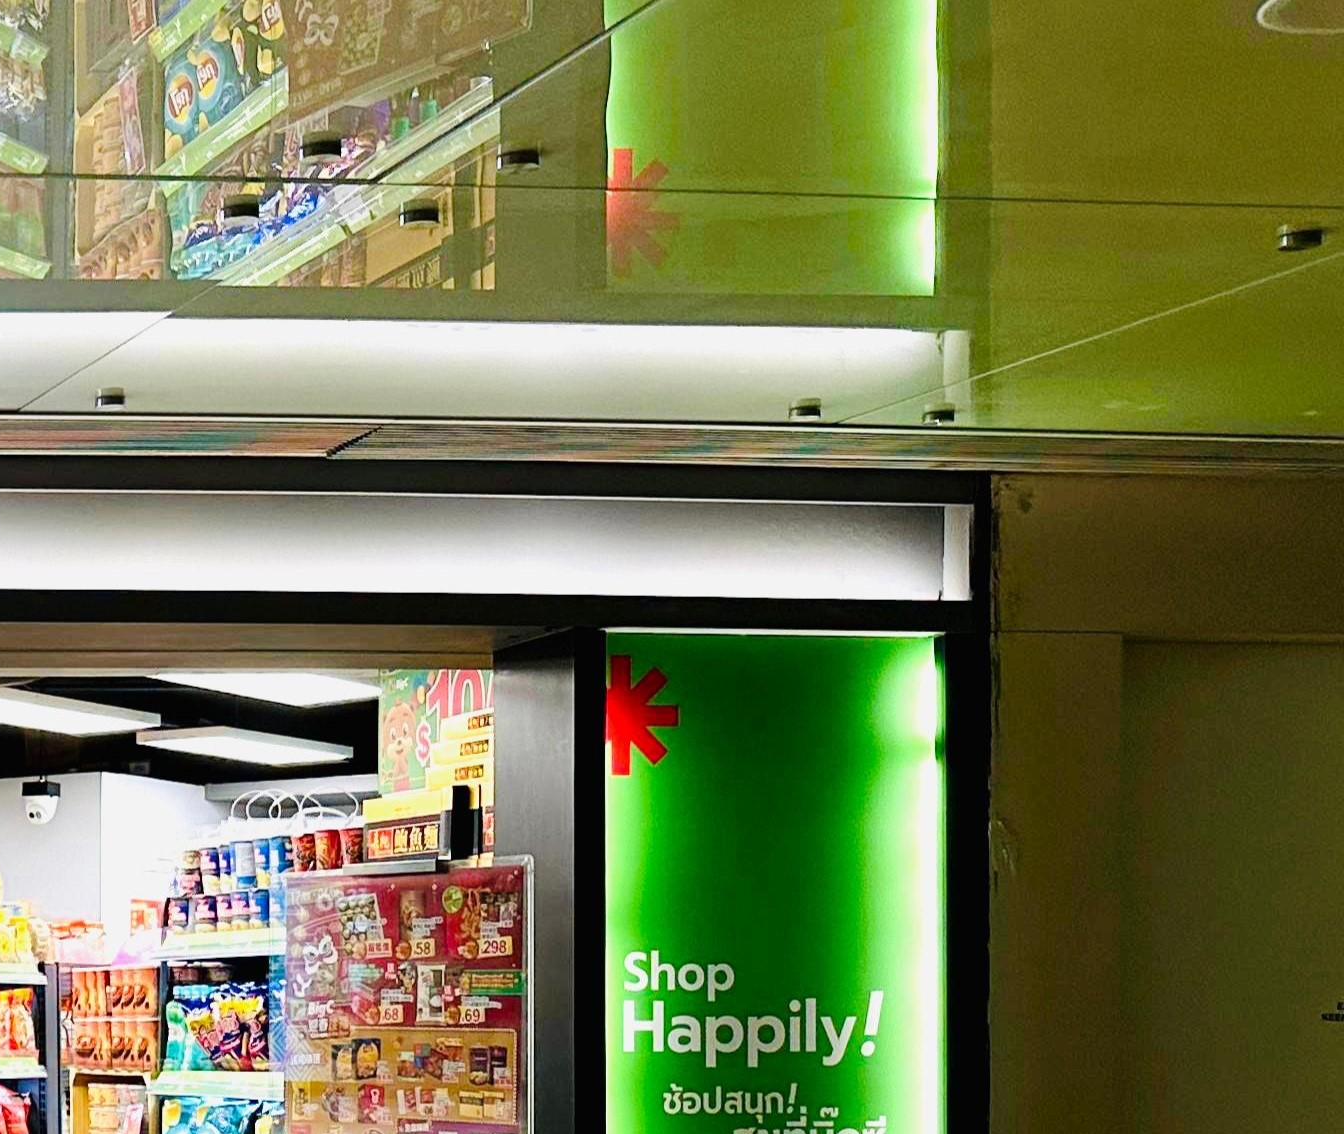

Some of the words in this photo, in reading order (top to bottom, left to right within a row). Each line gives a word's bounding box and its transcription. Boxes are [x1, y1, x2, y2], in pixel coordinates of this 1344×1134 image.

[623, 950, 735, 1002] Shop
[622, 990, 884, 1068] Happily!
[663, 1083, 798, 1125] ช้อปสนุก!
